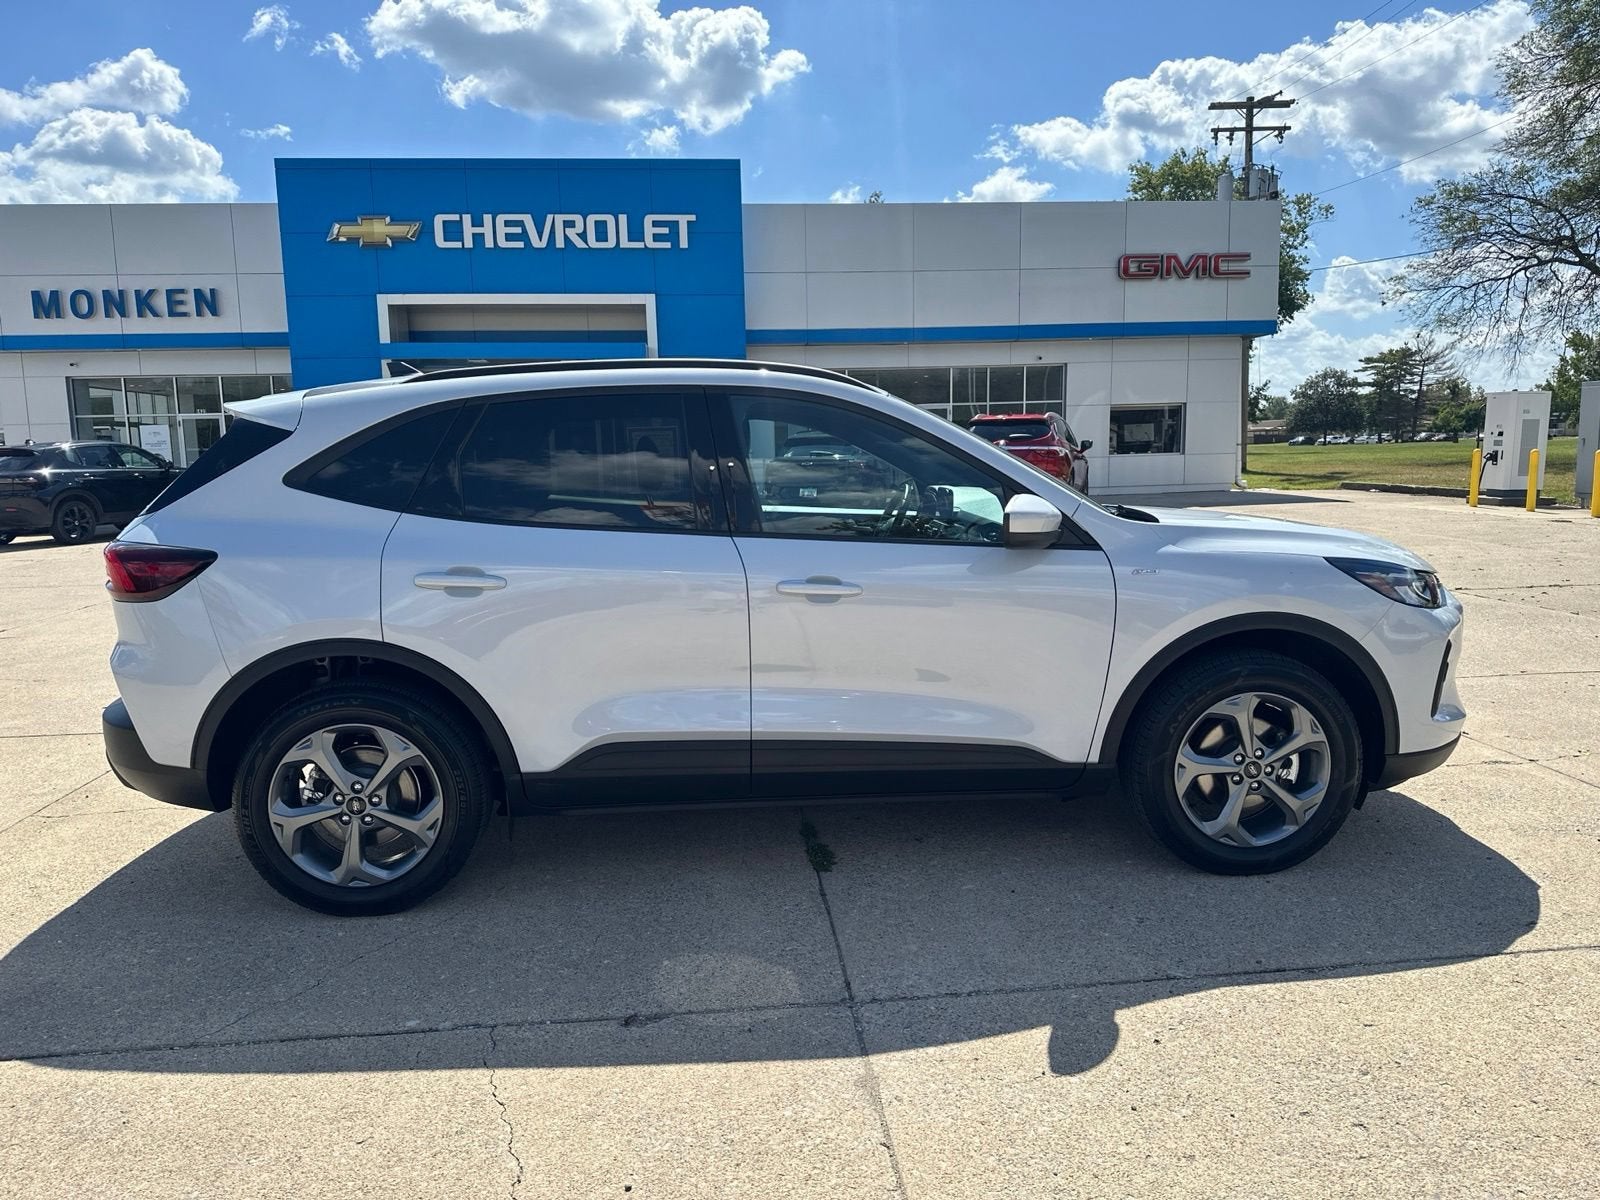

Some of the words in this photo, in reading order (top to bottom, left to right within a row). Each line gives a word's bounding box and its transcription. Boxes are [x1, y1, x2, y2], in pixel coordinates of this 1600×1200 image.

[433, 213, 697, 249] CHEVROLET
[1118, 252, 1251, 280] GMC
[30, 288, 221, 320] MONKEN
